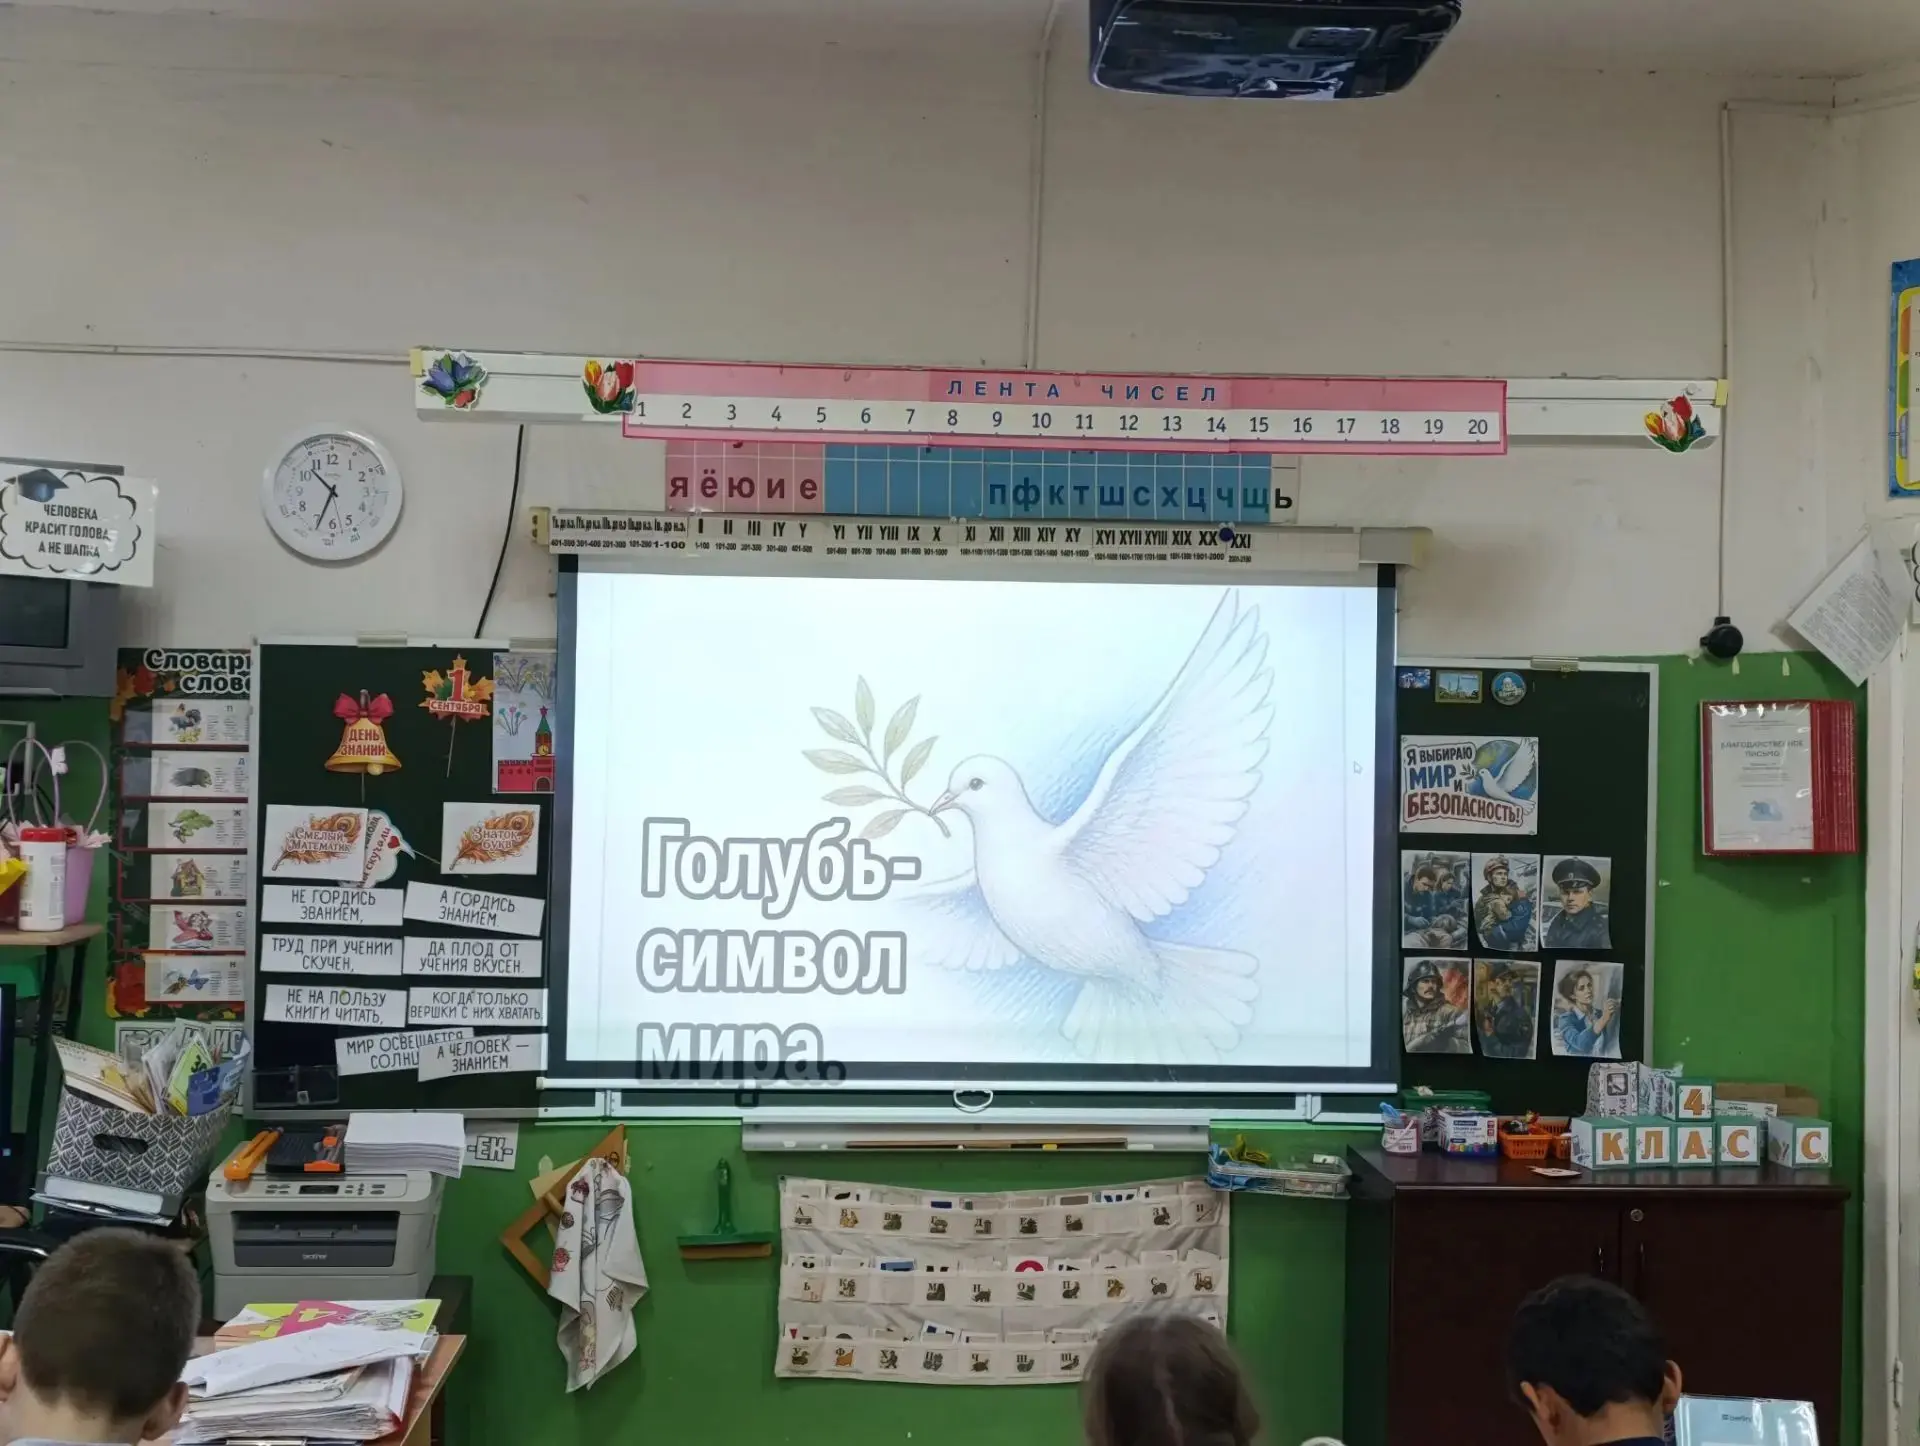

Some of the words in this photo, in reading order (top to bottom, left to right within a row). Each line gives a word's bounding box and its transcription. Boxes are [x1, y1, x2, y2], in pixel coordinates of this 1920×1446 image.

[947, 380, 1060, 398] ЛЕНТА
[1101, 385, 1216, 401] ЧИСЕЛ
[638, 402, 647, 418] 1
[681, 403, 692, 419] 2
[726, 404, 737, 420] 3
[771, 405, 782, 422] 4
[816, 407, 826, 423] 5
[860, 408, 871, 423] 6
[905, 408, 916, 424] 7
[947, 410, 958, 426] 8
[992, 411, 1003, 427] 9
[1031, 412, 1052, 428] 10
[1075, 414, 1093, 430] 11
[1119, 415, 1139, 431] 12
[1162, 415, 1182, 432] 13
[1206, 416, 1226, 433] 14
[1250, 417, 1269, 433] 15
[1293, 417, 1313, 433] 16
[1336, 418, 1356, 434] 17
[1380, 418, 1400, 434] 18
[1424, 419, 1444, 435] 19
[1467, 419, 1488, 435] 20
[312, 459, 321, 470] 11
[326, 453, 339, 465] 12
[348, 459, 352, 471] 1
[300, 470, 312, 482] 10
[358, 471, 366, 482] 2
[296, 487, 303, 496] 9
[363, 487, 370, 497] 3
[44, 504, 98, 521] ЧЕЛОВЕКА
[298, 501, 306, 512] 8
[358, 502, 366, 512] 4
[328, 518, 337, 529] 6
[345, 514, 353, 526] 5
[25, 521, 67, 536] КРАСИТ
[69, 524, 111, 541] ГОЛОВА
[698, 518, 703, 534] I
[724, 519, 733, 535] II
[748, 520, 761, 536] III
[907, 526, 920, 541] IX
[932, 526, 941, 541] X
[965, 525, 976, 541] XI
[989, 526, 1004, 541] XII
[1013, 526, 1031, 541] XIII
[1171, 530, 1192, 546] XIX
[1198, 530, 1218, 546] XX
[1230, 533, 1251, 549] XXI
[38, 542, 45, 553] А
[48, 542, 61, 555] НЕ
[64, 544, 100, 557] ШАПКА
[653, 541, 686, 549] 1-100
[144, 649, 250, 675] Словар
[448, 669, 465, 701] 1
[430, 701, 481, 713] СЕНТЯБРЯ
[349, 728, 380, 742] ДЕНЬ
[340, 743, 386, 756] ЗНАНИЙ
[1407, 748, 1416, 766] Я
[1419, 746, 1473, 763] ВЫБИРАЮ
[1409, 765, 1457, 790] МИР
[1407, 792, 1521, 823] БЕЗОПАСНОСТЬ!
[641, 817, 922, 920] Голубь-
[292, 889, 306, 904] НЕ
[312, 889, 376, 906] ГОРДИСЬ
[440, 890, 447, 903] А
[453, 890, 516, 912] ГОРДИСЬ
[300, 906, 364, 924] ЗВАНИЕМ,
[272, 938, 304, 954] ТРУД
[310, 939, 337, 953] ПРИ
[343, 940, 393, 955] УЧЕНИИ
[428, 943, 445, 958] ДА
[451, 942, 494, 959] ПЛОД
[500, 942, 519, 957] ОТ
[302, 955, 355, 972] СКУЧЕН,
[419, 957, 468, 972] УЧЕНИЯ
[473, 958, 525, 974] ВКУСЕН.
[636, 927, 907, 995] символ
[288, 989, 302, 1004] НЕ
[309, 990, 324, 1004] НА
[329, 990, 386, 1007] ПОЛЬЗУ
[432, 991, 473, 1006] КОГДА
[477, 991, 529, 1006] ТОЛЬКО
[285, 1004, 330, 1020] КНИГИ
[335, 1007, 384, 1025] ЧИТАТЬ,
[410, 1004, 457, 1019] ВЕРШКИ
[462, 1006, 468, 1019] С
[472, 1006, 494, 1019] НИХ
[346, 1040, 375, 1055] МИР
[437, 1045, 445, 1059] А
[449, 1037, 511, 1057] ЧЕЛОВЕК
[1684, 1088, 1706, 1115] 4
